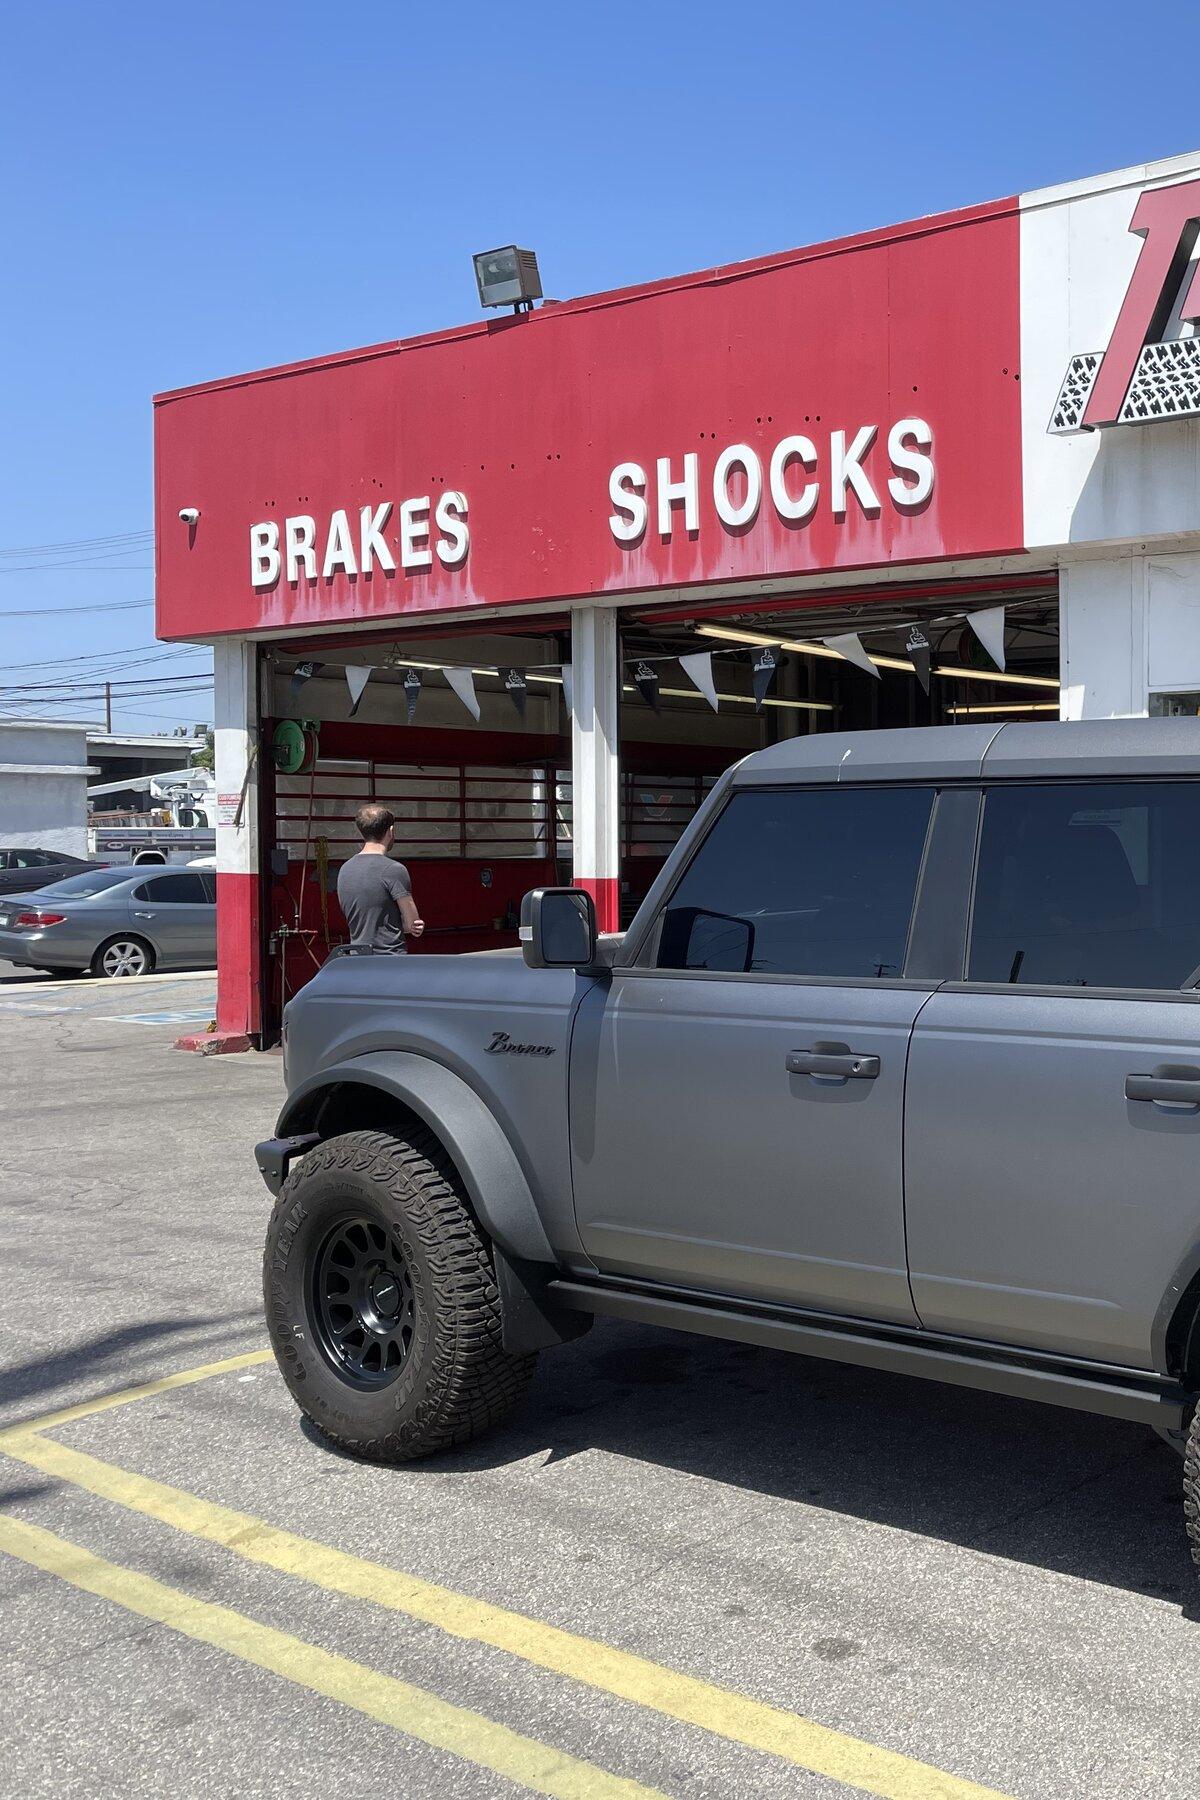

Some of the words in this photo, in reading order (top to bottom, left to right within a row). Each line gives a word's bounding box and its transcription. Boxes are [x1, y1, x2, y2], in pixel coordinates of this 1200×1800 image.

[608, 417, 935, 542] SHOCKS
[250, 490, 470, 588] BRAKES
[483, 1031, 557, 1056] Bronco
